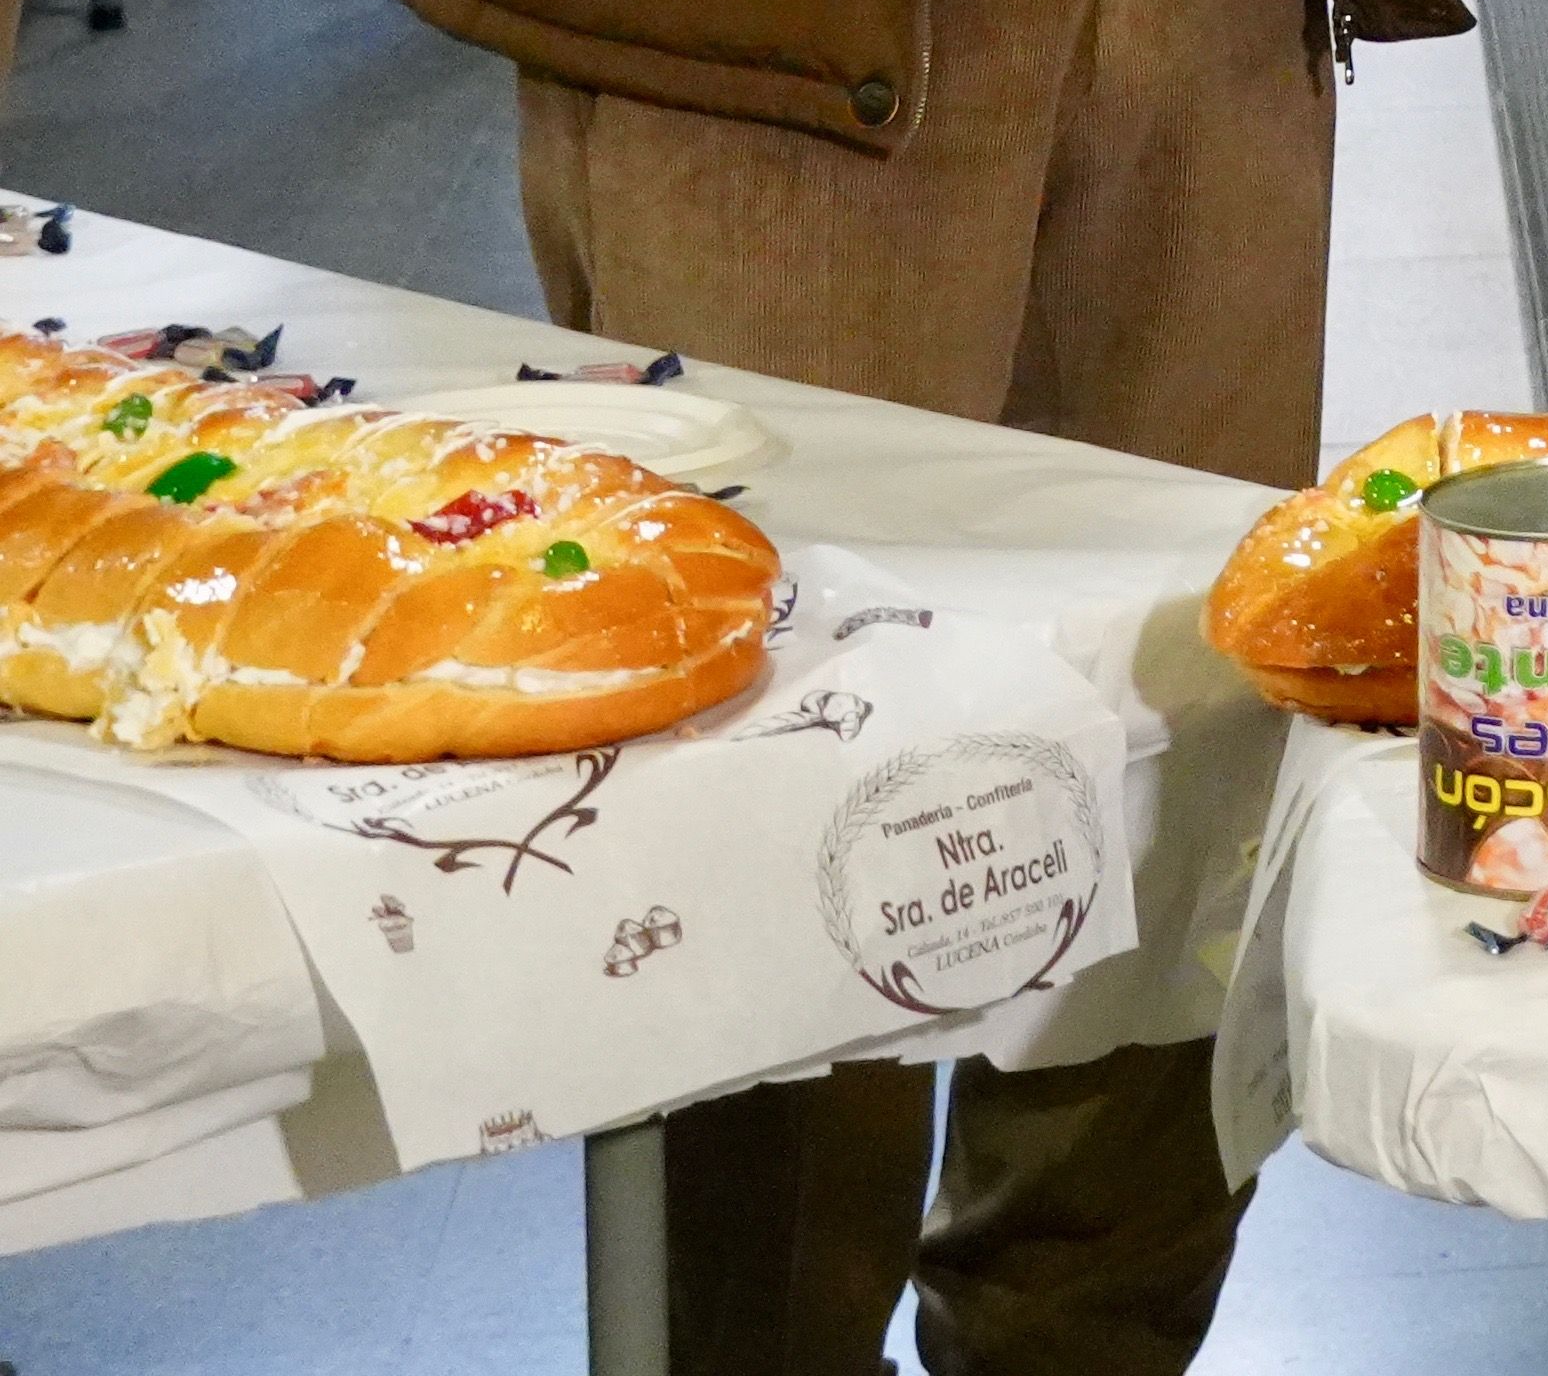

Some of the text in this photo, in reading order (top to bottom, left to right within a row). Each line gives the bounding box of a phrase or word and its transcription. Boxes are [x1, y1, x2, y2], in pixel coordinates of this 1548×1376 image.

[936, 829, 1004, 869] Ntra.
[880, 839, 1068, 936] Sra. de Araceli
[936, 935, 1000, 971] LUCENA
